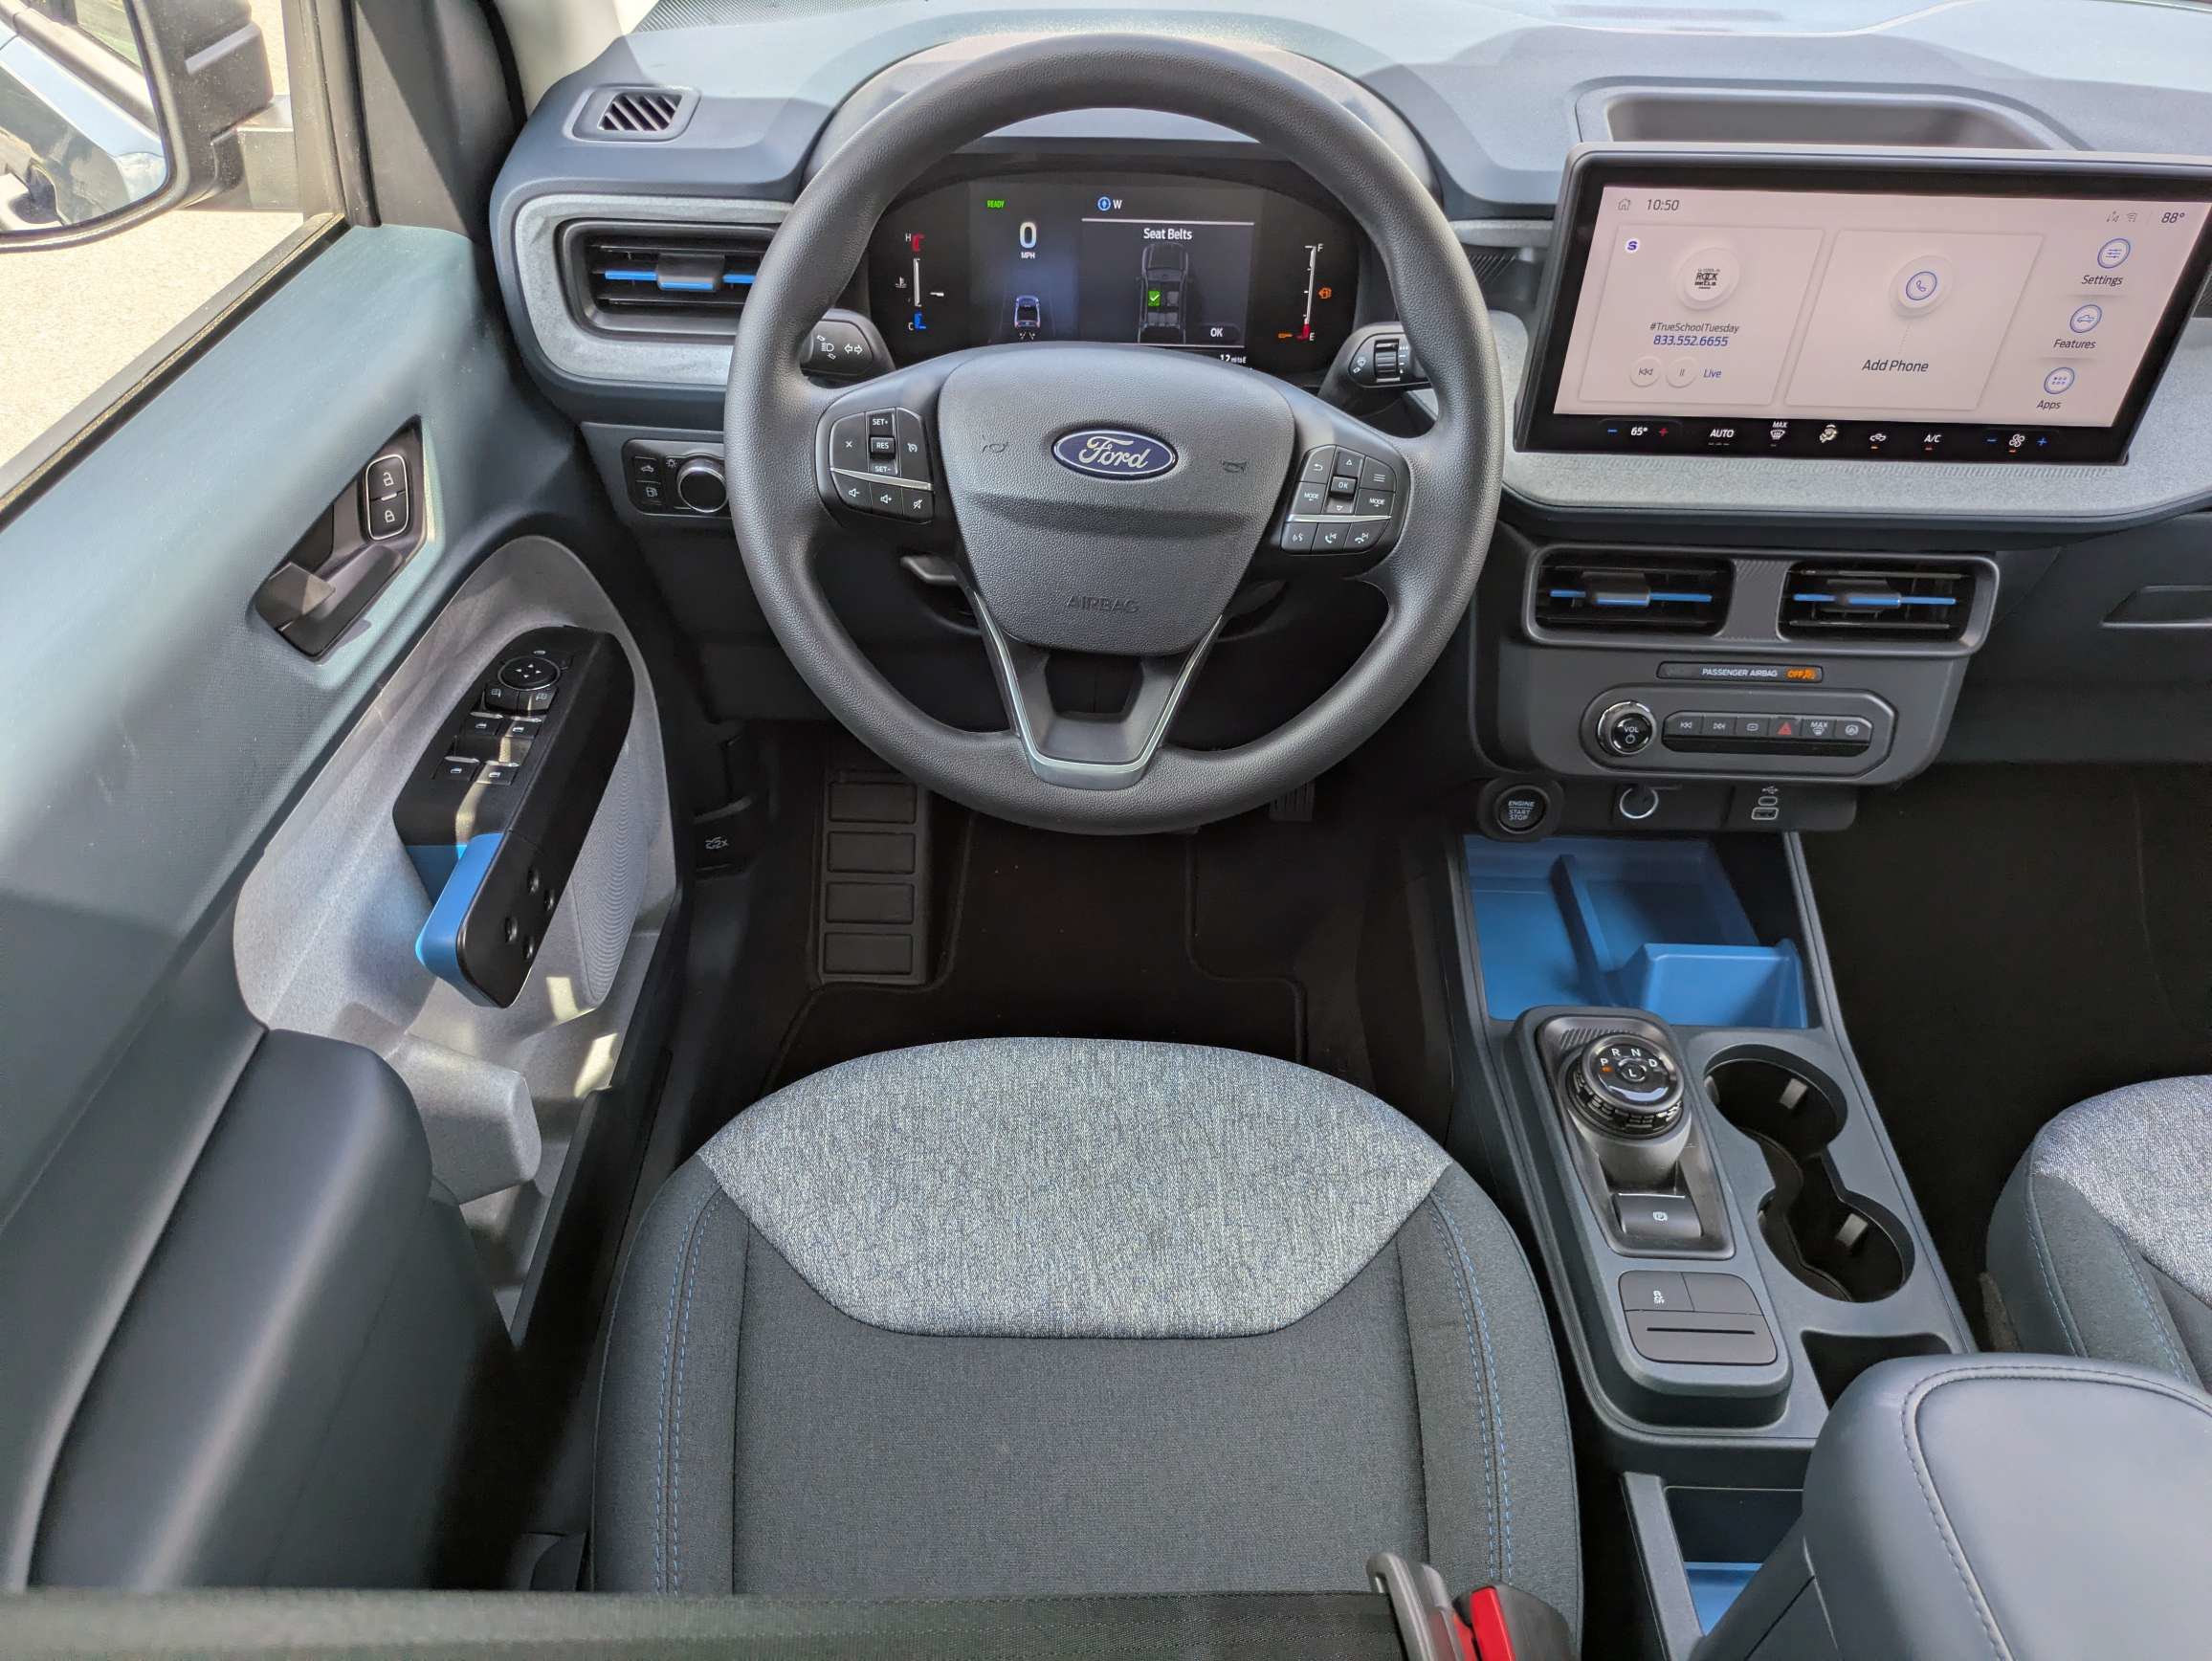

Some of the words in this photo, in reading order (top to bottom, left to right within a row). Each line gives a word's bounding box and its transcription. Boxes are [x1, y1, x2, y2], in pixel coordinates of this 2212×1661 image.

[987, 200, 1005, 209] READY
[1113, 199, 1122, 210] W
[1647, 199, 1679, 211] 10:50
[1019, 221, 1037, 249] 0
[1143, 228, 1166, 239] Seat
[1167, 229, 1193, 240] Belts
[1317, 243, 1324, 253] F
[2081, 275, 2123, 287] Settings
[908, 321, 915, 331] C
[1649, 321, 1739, 334] #TrueSchoolTuesday
[1210, 327, 1224, 338] OK
[1309, 332, 1315, 342] E
[1653, 335, 1729, 346] 833.552.6655
[2053, 339, 2096, 350] Features
[1862, 359, 1887, 372] Add
[1889, 360, 1929, 373] Phone
[1703, 368, 1722, 378] Live
[2036, 399, 2061, 411] Apps
[1710, 429, 1735, 438] AUTO
[1924, 433, 1941, 443] A/C
[875, 441, 890, 450] RES
[1078, 435, 1152, 469] Ford
[1068, 596, 1139, 613] AIRBAG
[1701, 668, 1749, 676] PASSENGER
[1750, 669, 1778, 677] AIRBAG
[1600, 1057, 1608, 1066] P
[1611, 1048, 1621, 1056] R
[1630, 1048, 1642, 1056] N
[1648, 1058, 1658, 1067] D
[1628, 1069, 1637, 1077] L
